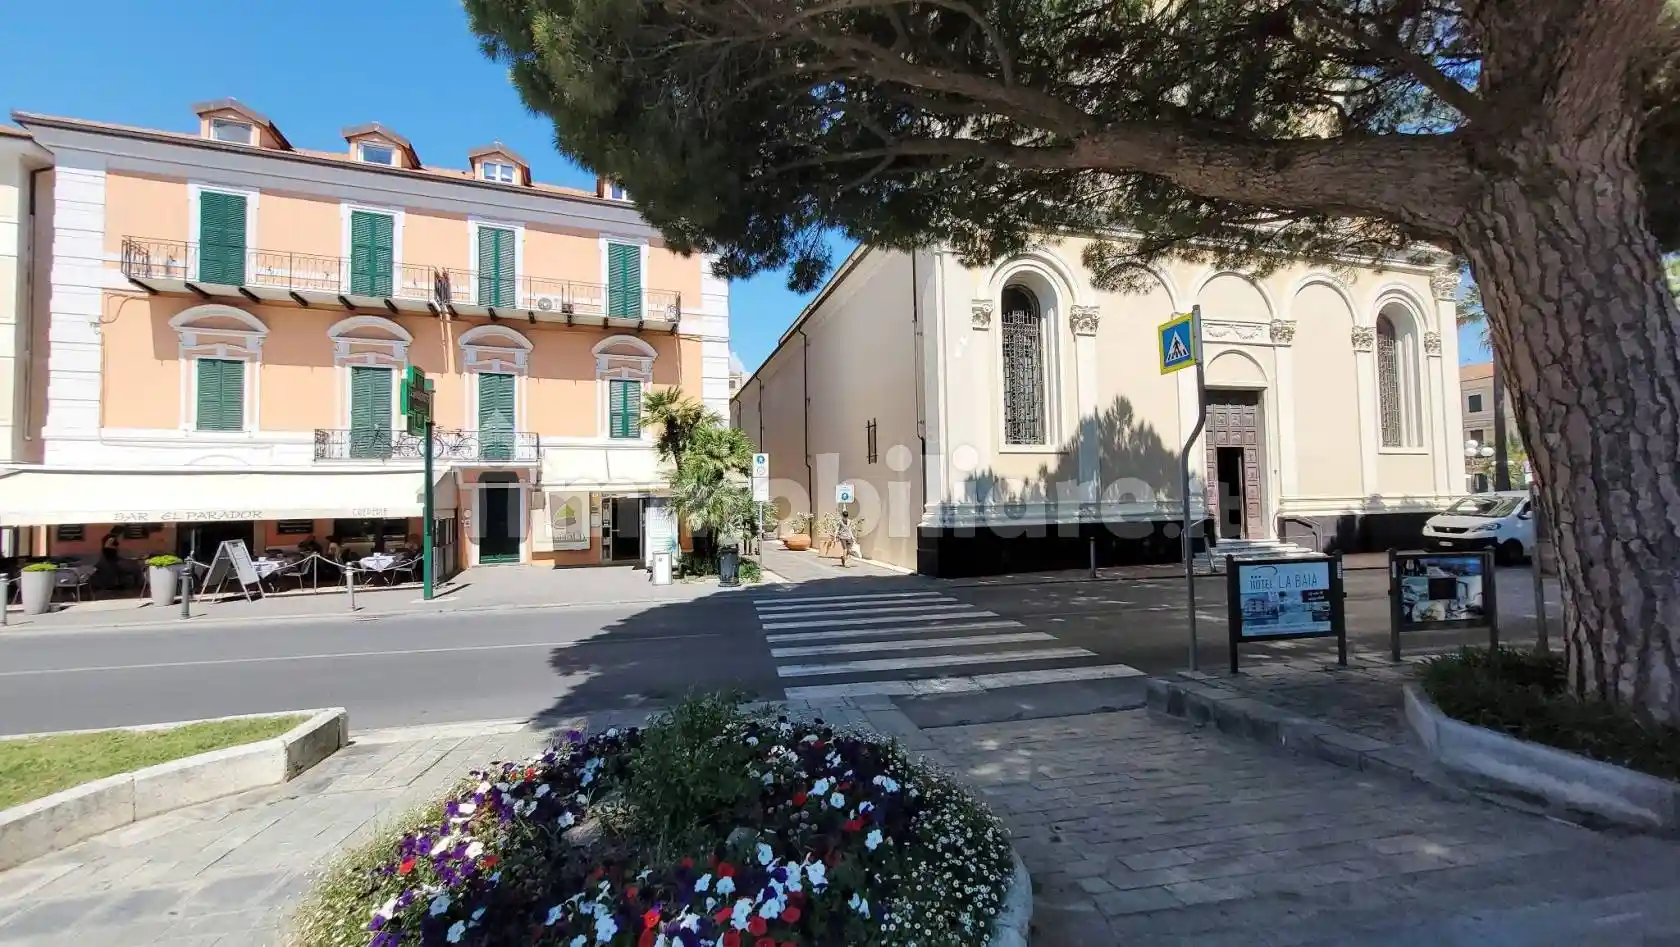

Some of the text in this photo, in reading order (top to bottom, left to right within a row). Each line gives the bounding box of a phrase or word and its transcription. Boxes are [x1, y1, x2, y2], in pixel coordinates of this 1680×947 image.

[113, 510, 263, 521] BAR EL PARADOR
[1249, 572, 1318, 590] HOTEL LA BAIA
